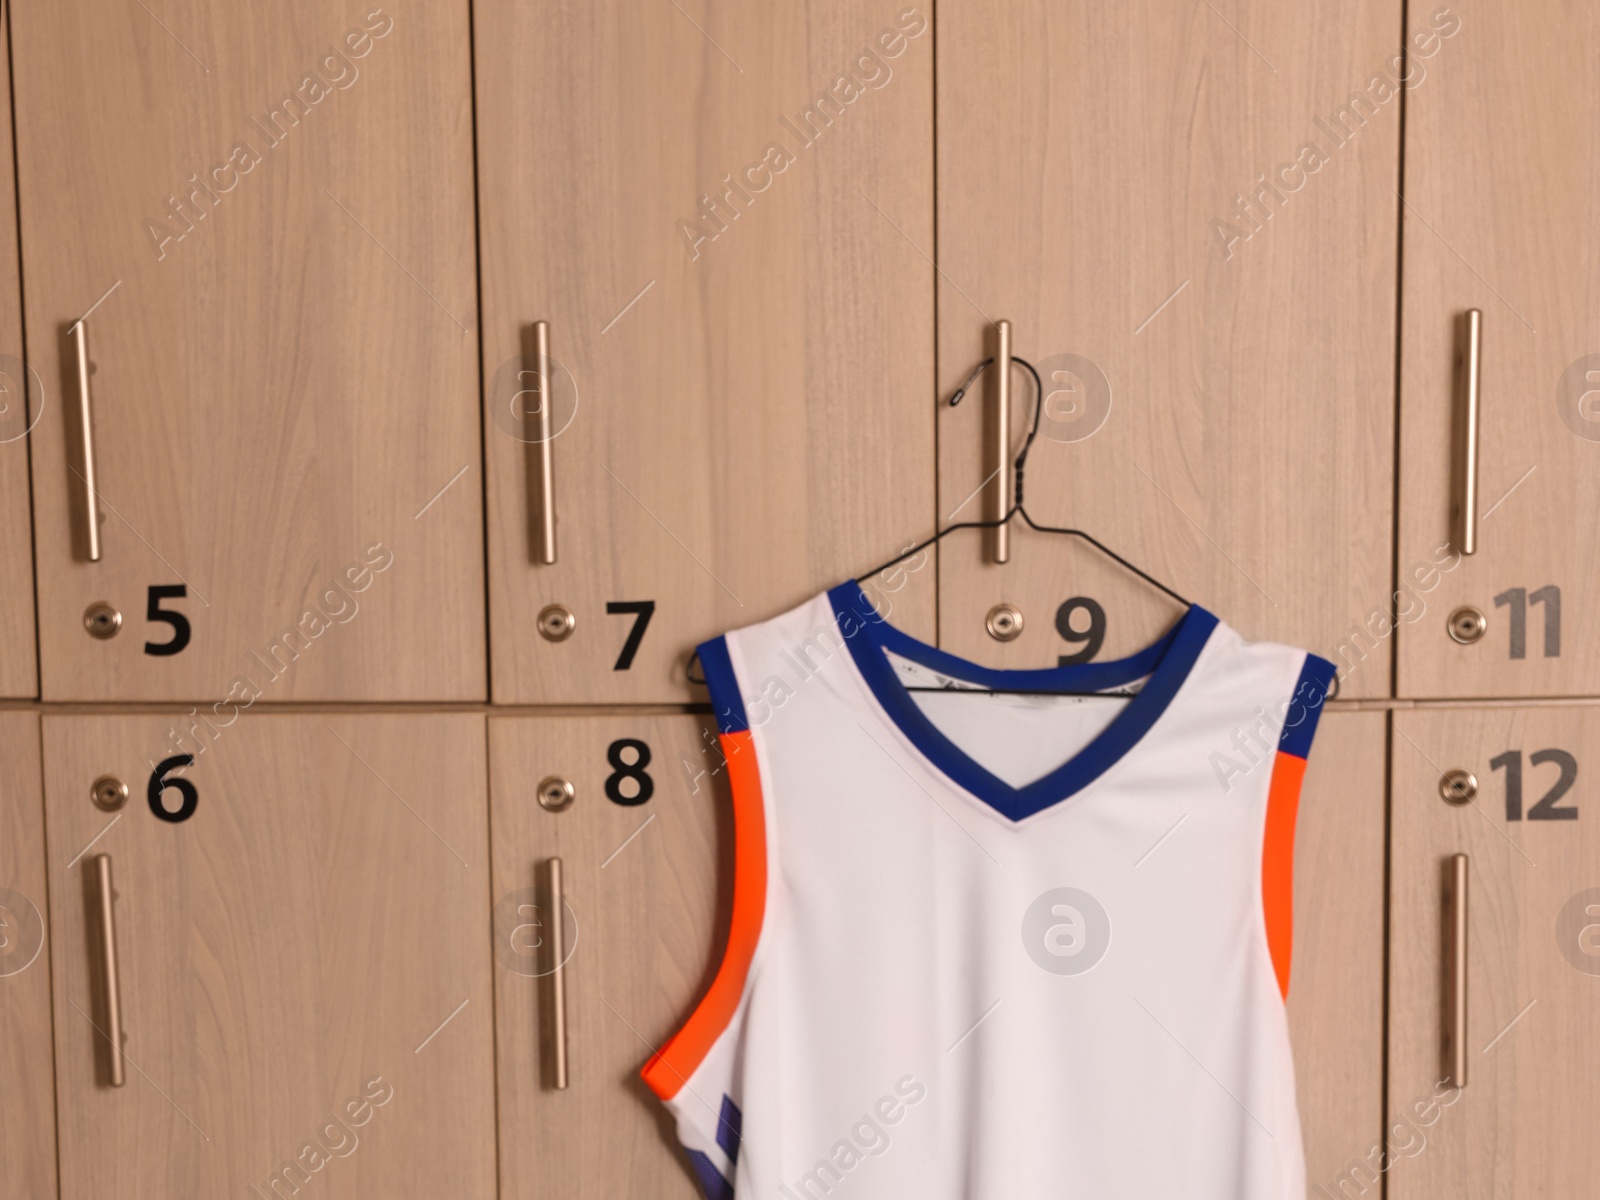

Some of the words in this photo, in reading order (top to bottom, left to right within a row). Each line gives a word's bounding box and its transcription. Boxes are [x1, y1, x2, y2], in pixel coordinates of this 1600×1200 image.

[144, 584, 192, 657] 5
[606, 600, 656, 672] 7
[1054, 596, 1108, 666] 9
[1493, 584, 1562, 660] 11
[147, 753, 199, 823] 6
[604, 738, 655, 806] 8
[1488, 748, 1580, 822] 12
